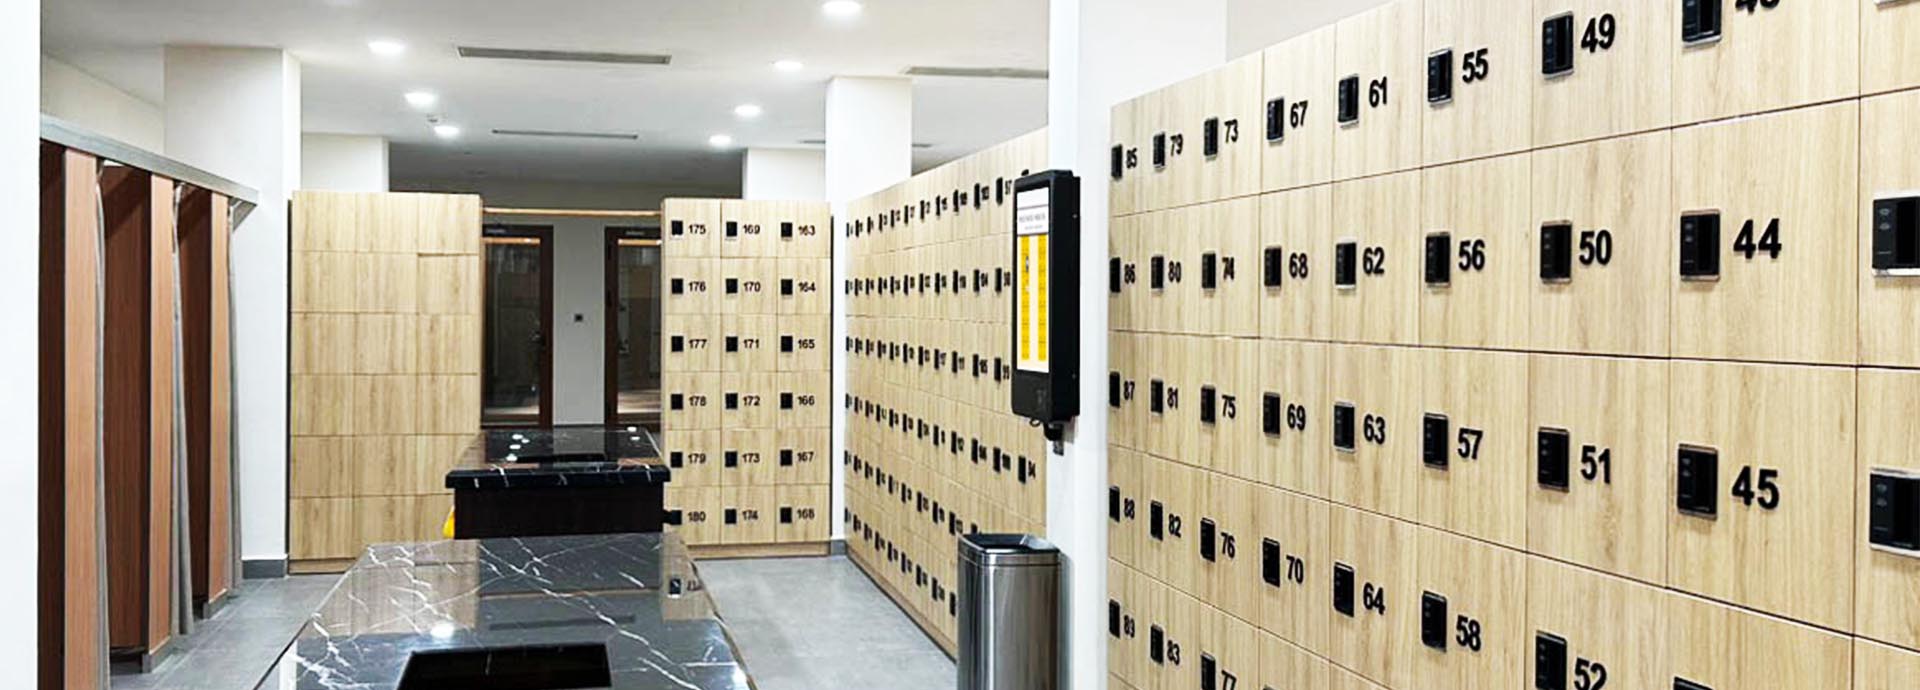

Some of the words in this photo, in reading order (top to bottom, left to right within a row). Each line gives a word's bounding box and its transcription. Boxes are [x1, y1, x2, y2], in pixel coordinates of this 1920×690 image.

[1580, 13, 1616, 54] 49
[1462, 47, 1489, 84] 55
[1368, 76, 1388, 109] 61
[1289, 100, 1309, 129] 67
[1224, 118, 1239, 143] 73
[1170, 133, 1184, 157] 79
[1126, 147, 1138, 170] 85
[688, 224, 707, 235] 175
[743, 224, 761, 235] 169
[1732, 217, 1783, 260] 44
[1458, 238, 1486, 272] 56
[1578, 229, 1613, 267] 50
[1123, 263, 1136, 285] 86
[1167, 260, 1182, 284] 80
[1221, 256, 1235, 281] 74
[1288, 252, 1309, 280] 68
[1362, 246, 1385, 277] 62
[688, 281, 707, 292] 176
[743, 281, 762, 293] 170
[798, 281, 817, 293] 164
[688, 338, 708, 349] 177
[743, 338, 760, 349] 171
[797, 338, 816, 350] 165
[743, 395, 761, 407] 172
[1123, 380, 1136, 401] 87
[1166, 387, 1179, 410] 81
[1221, 394, 1237, 420] 75
[1286, 403, 1307, 433] 69
[1363, 413, 1386, 446] 63
[796, 451, 814, 462] 167
[1457, 427, 1484, 461] 57
[687, 452, 707, 465] 179
[741, 452, 761, 464] 173
[1580, 444, 1611, 486] 51
[1731, 465, 1780, 511] 45
[687, 510, 707, 523] 180
[742, 509, 759, 522] 174
[1123, 497, 1136, 521] 88
[1168, 513, 1182, 539] 82
[1220, 531, 1236, 559] 76
[1285, 554, 1304, 585] 70
[1362, 582, 1386, 616] 64
[1455, 614, 1482, 653] 58
[1166, 639, 1181, 666] 83
[1221, 669, 1237, 690] 77
[1573, 657, 1607, 690] 52
